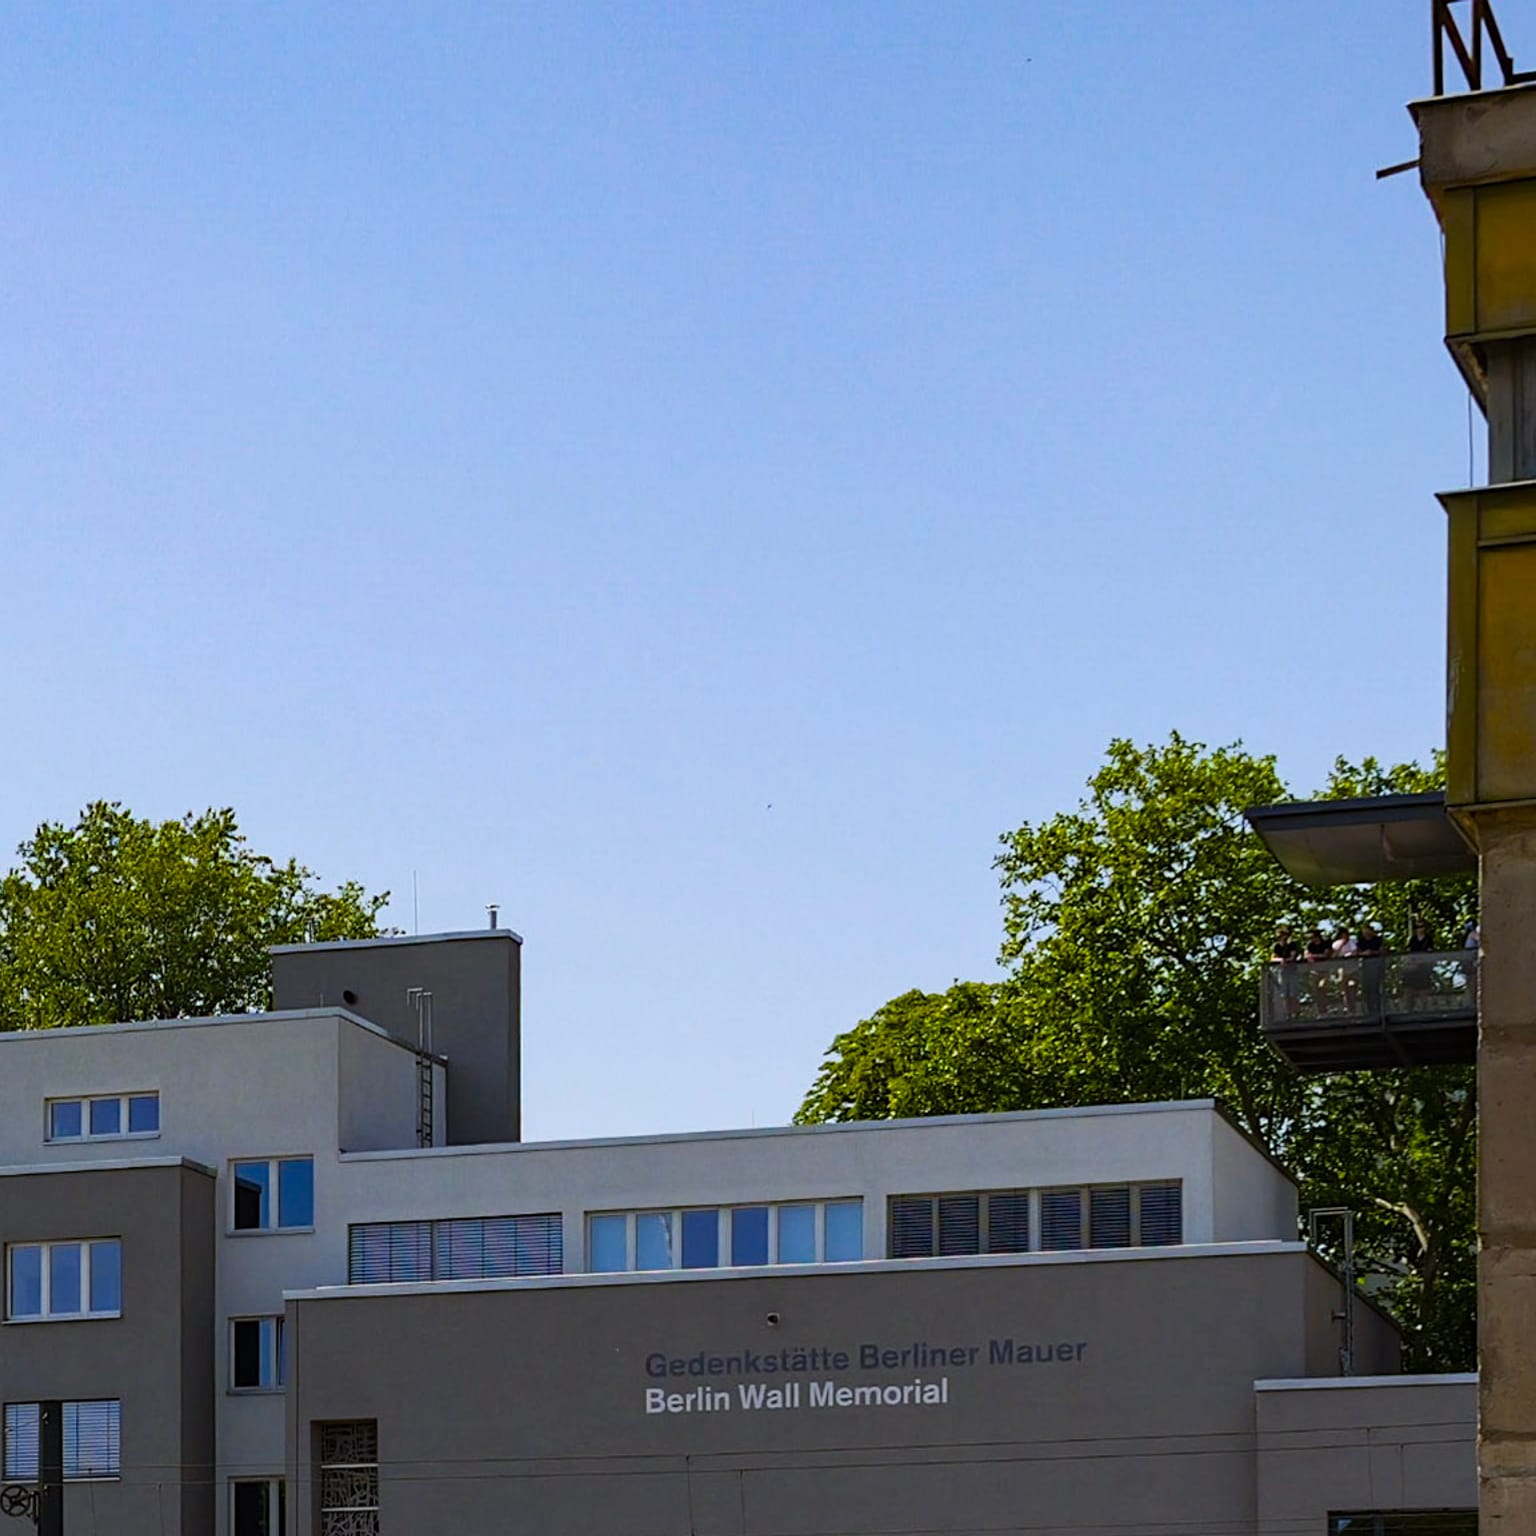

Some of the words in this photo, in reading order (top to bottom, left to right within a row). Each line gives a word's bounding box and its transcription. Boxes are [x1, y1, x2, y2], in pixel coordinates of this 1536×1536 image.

[645, 1347, 849, 1378] Gedenkstätte
[859, 1342, 980, 1369] Berliner
[989, 1339, 1087, 1365] Mauer
[645, 1386, 730, 1414] Berlin
[738, 1382, 799, 1409] Wall
[809, 1377, 948, 1407] Memorial
